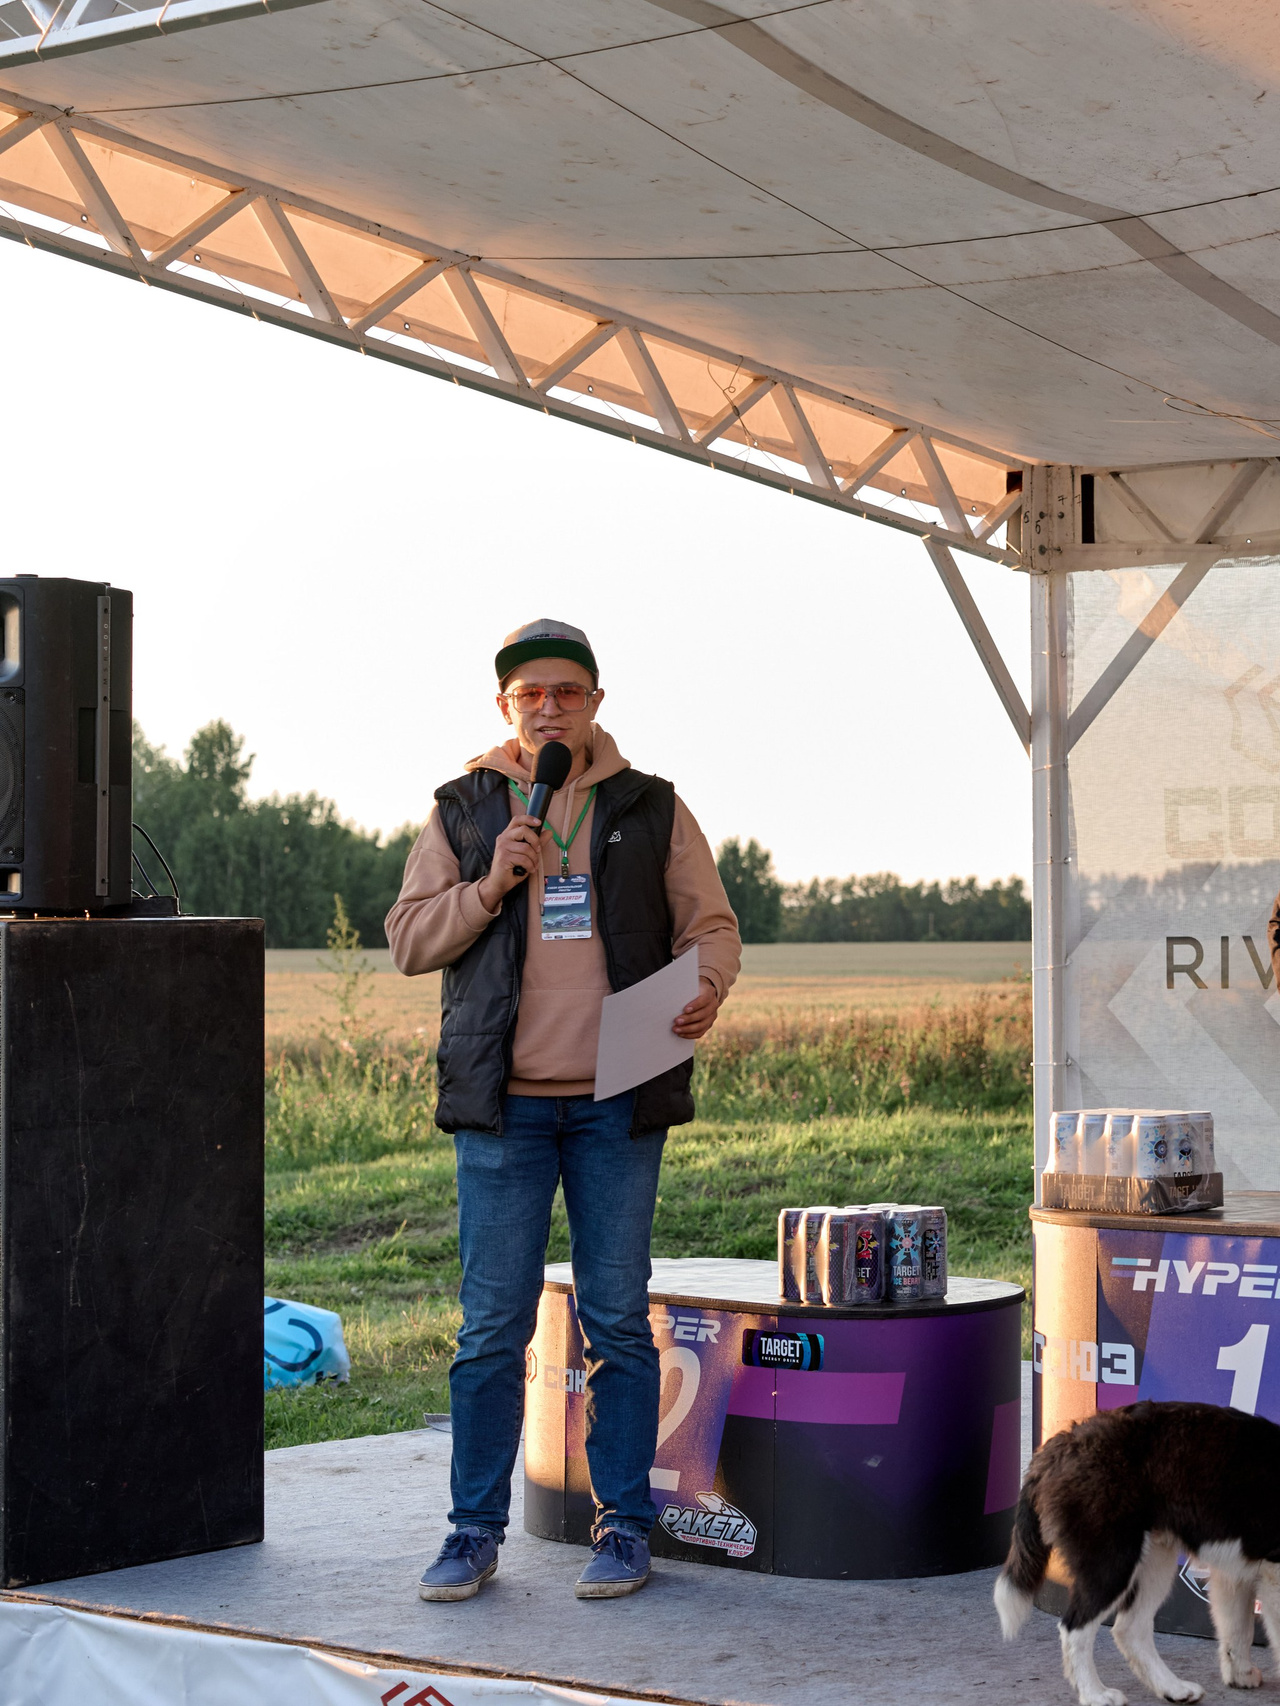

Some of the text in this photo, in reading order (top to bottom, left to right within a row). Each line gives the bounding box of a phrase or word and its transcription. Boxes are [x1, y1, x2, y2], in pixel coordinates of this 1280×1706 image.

[1059, 1183, 1095, 1200] TARGET
[893, 1265, 920, 1276] TARGET
[760, 1337, 802, 1357] TARGET
[1216, 1323, 1270, 1417] 1
[660, 1505, 756, 1544] РАКЕТА
[685, 1535, 754, 1551] СПОРТИВНО-ТЕХНИЧЕСКИЙ
[728, 1549, 744, 1557] КЛУБ
